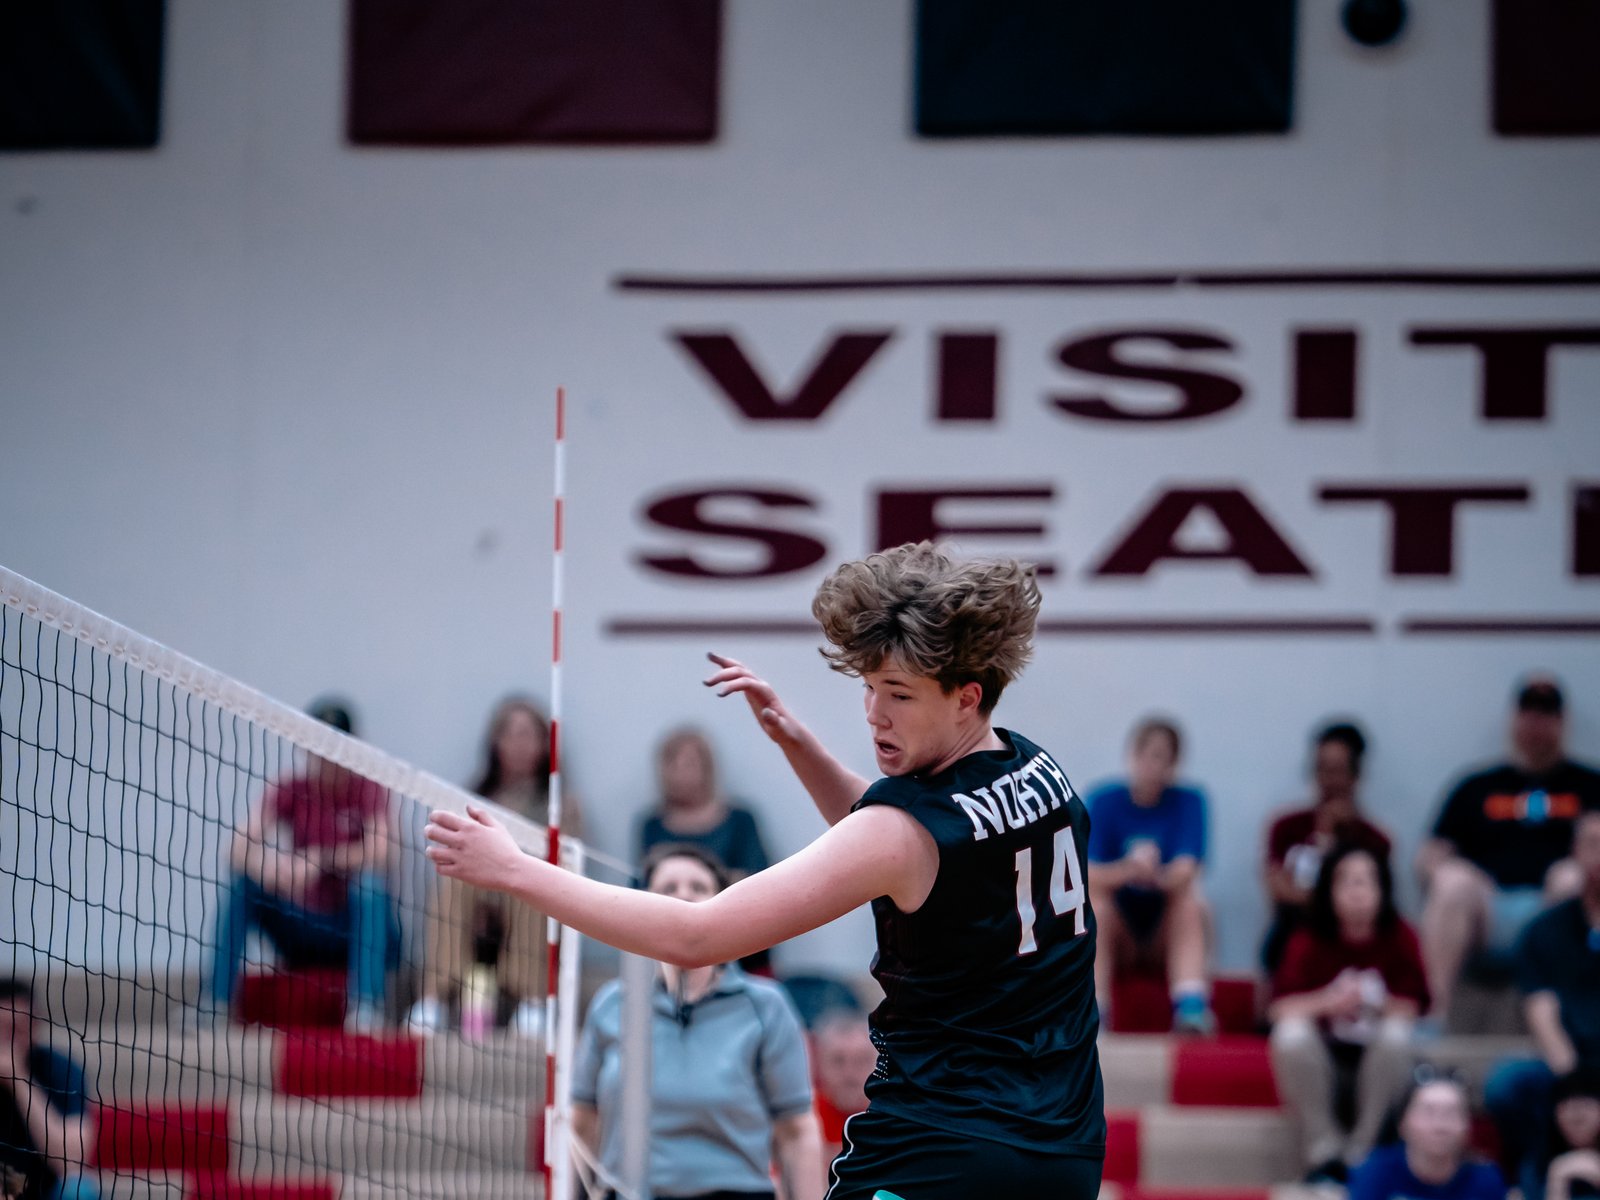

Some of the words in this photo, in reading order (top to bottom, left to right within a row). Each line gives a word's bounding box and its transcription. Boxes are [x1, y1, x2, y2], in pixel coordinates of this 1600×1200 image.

[668, 324, 1600, 425] VISIT
[951, 751, 1073, 841] NORTH
[1014, 825, 1087, 955] 14
